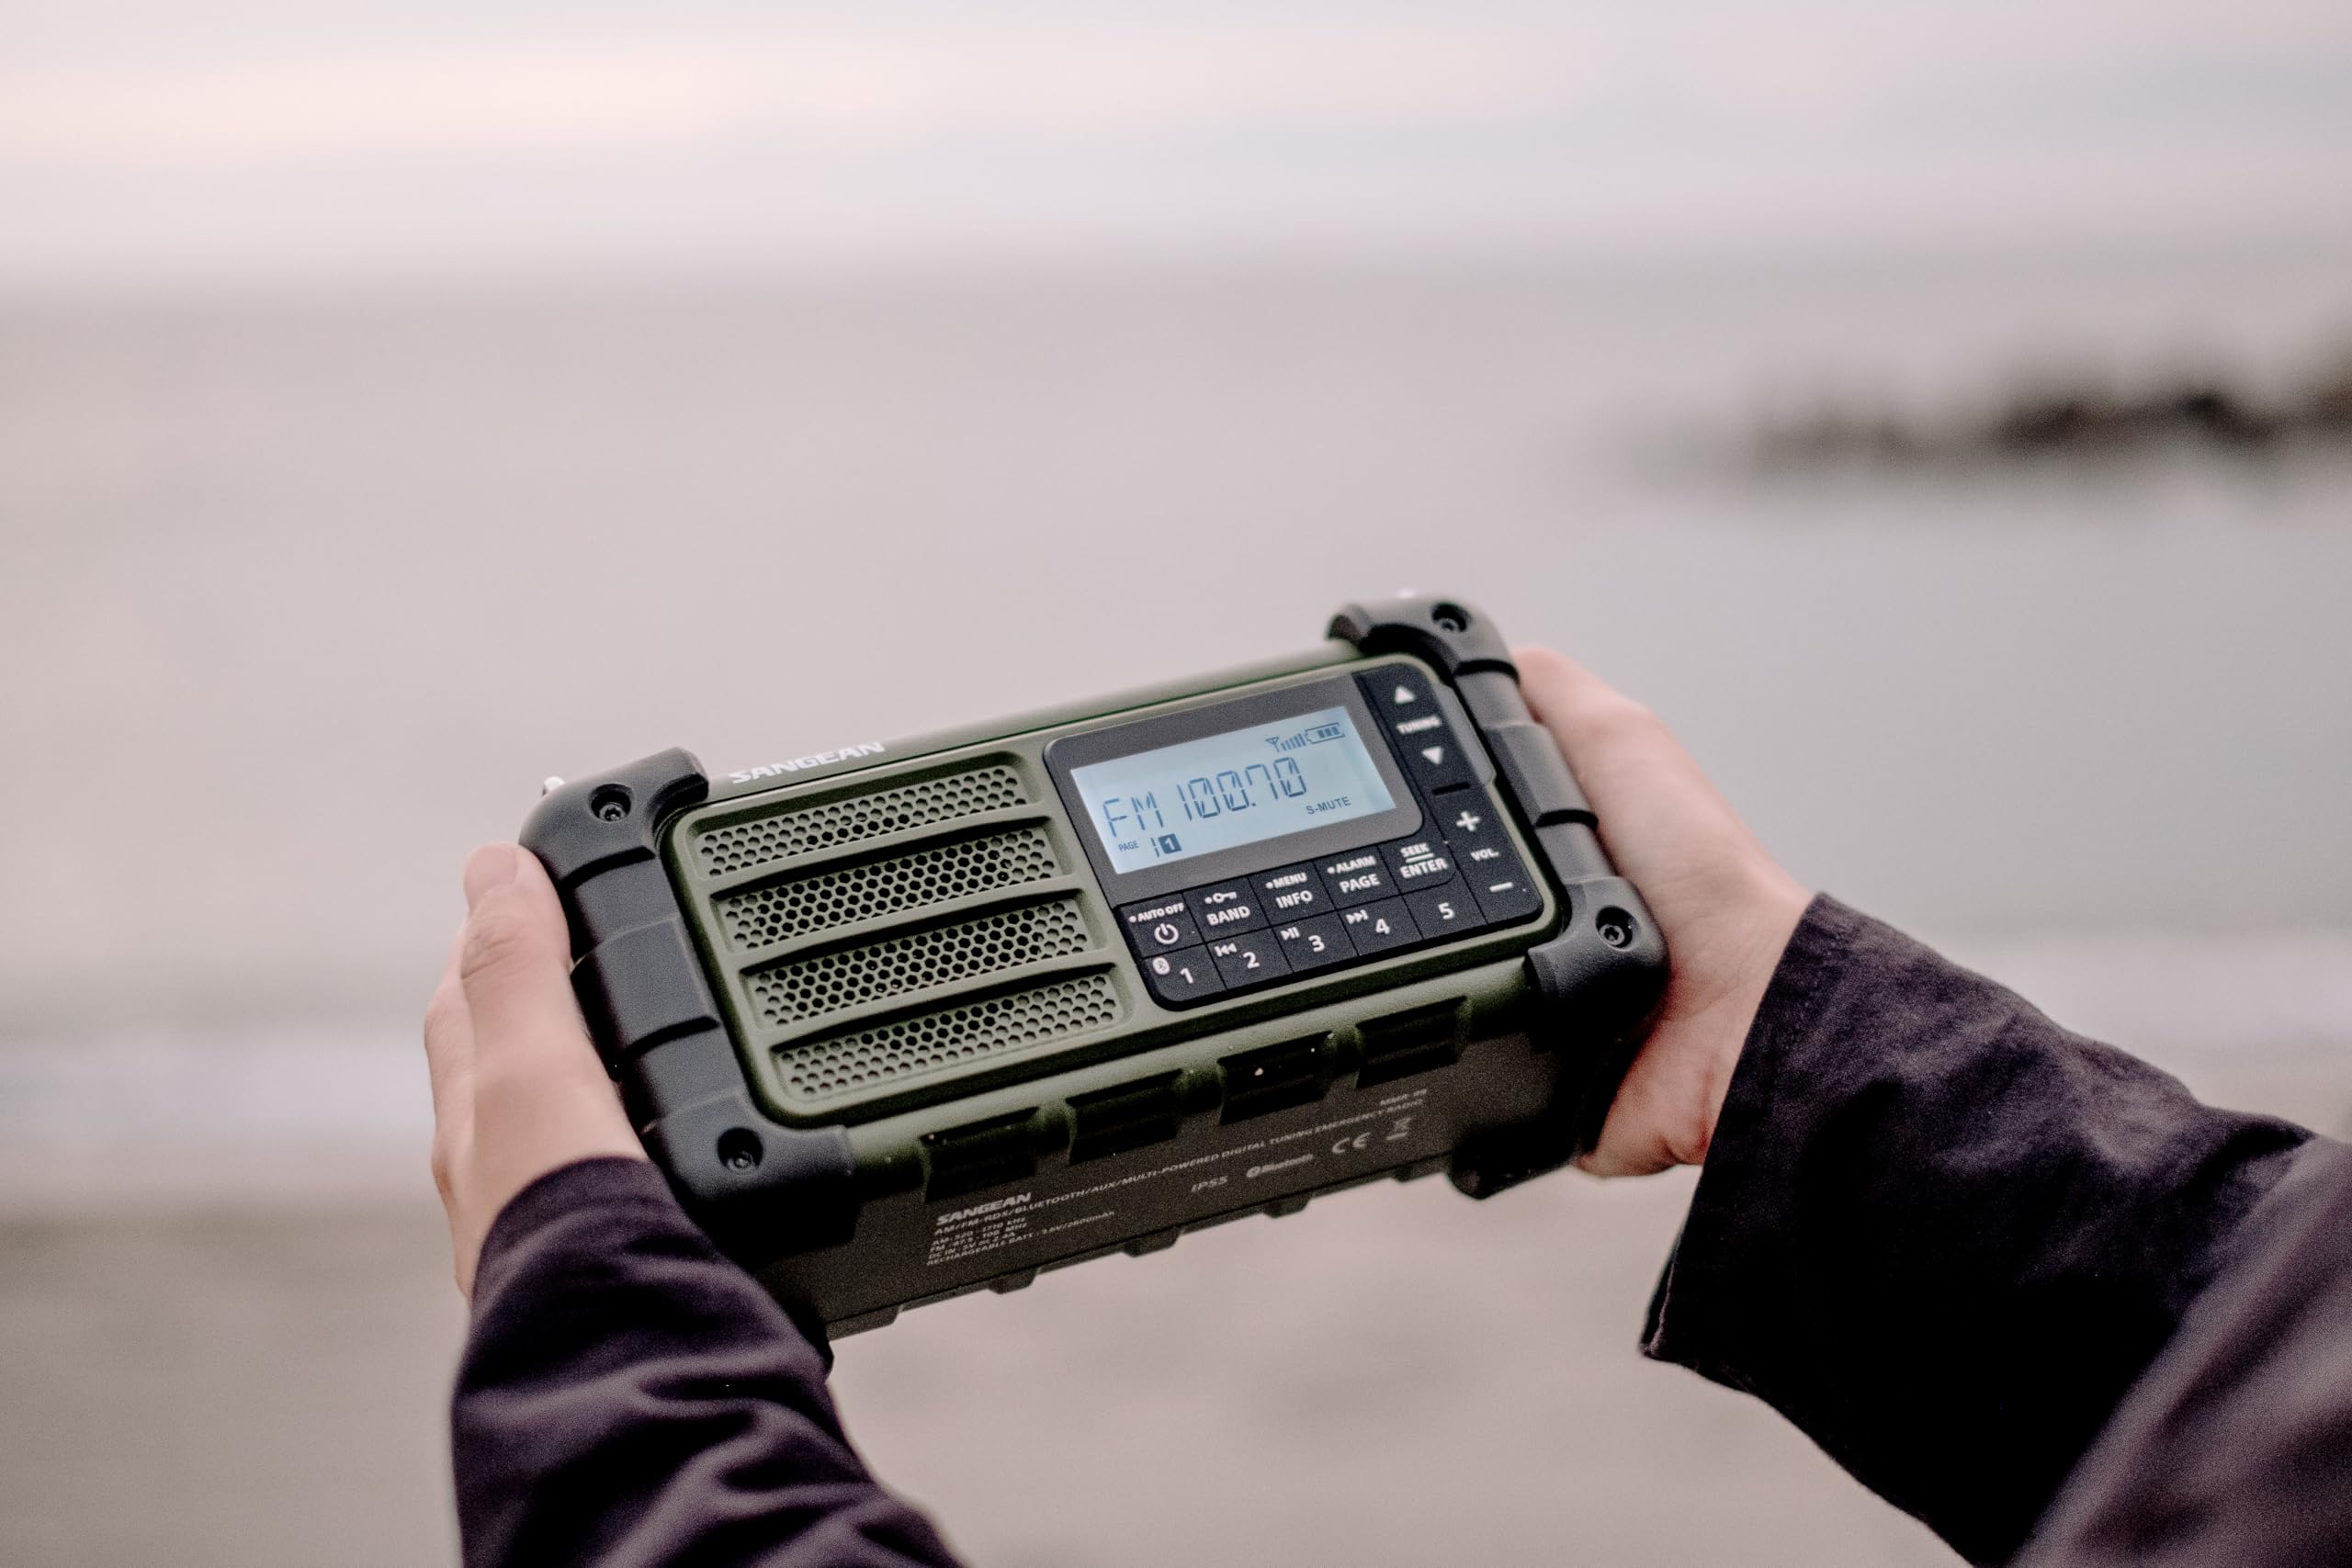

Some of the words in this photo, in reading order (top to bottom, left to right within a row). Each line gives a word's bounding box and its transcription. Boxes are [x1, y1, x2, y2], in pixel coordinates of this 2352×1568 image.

[1396, 716, 1442, 734] TUNING
[728, 741, 886, 784] SANGEAN
[1102, 791, 1164, 838] FM
[1177, 757, 1306, 819] 100.70
[1306, 796, 1351, 815] S-MUTE
[1118, 840, 1139, 852] PAGE
[1400, 842, 1430, 858] SEEK
[1470, 847, 1499, 862] VOL.
[1335, 855, 1377, 873] ALARM
[1399, 857, 1449, 879] ENTER
[1274, 872, 1308, 888] MENU
[1339, 874, 1381, 894] PAGE
[1275, 890, 1314, 909] INFO
[1137, 907, 1165, 922] AUTO
[1166, 902, 1185, 915] OFF
[1206, 906, 1250, 926] BAND
[1438, 902, 1455, 919] 5
[1375, 918, 1391, 935] 4
[1308, 934, 1325, 953] 3
[1243, 952, 1261, 969] 2
[1180, 967, 1194, 985] 1
[1221, 1140, 1266, 1158] DIGITAL
[1270, 1127, 1313, 1145] TUNING
[936, 1192, 1031, 1226] SANGEAN
